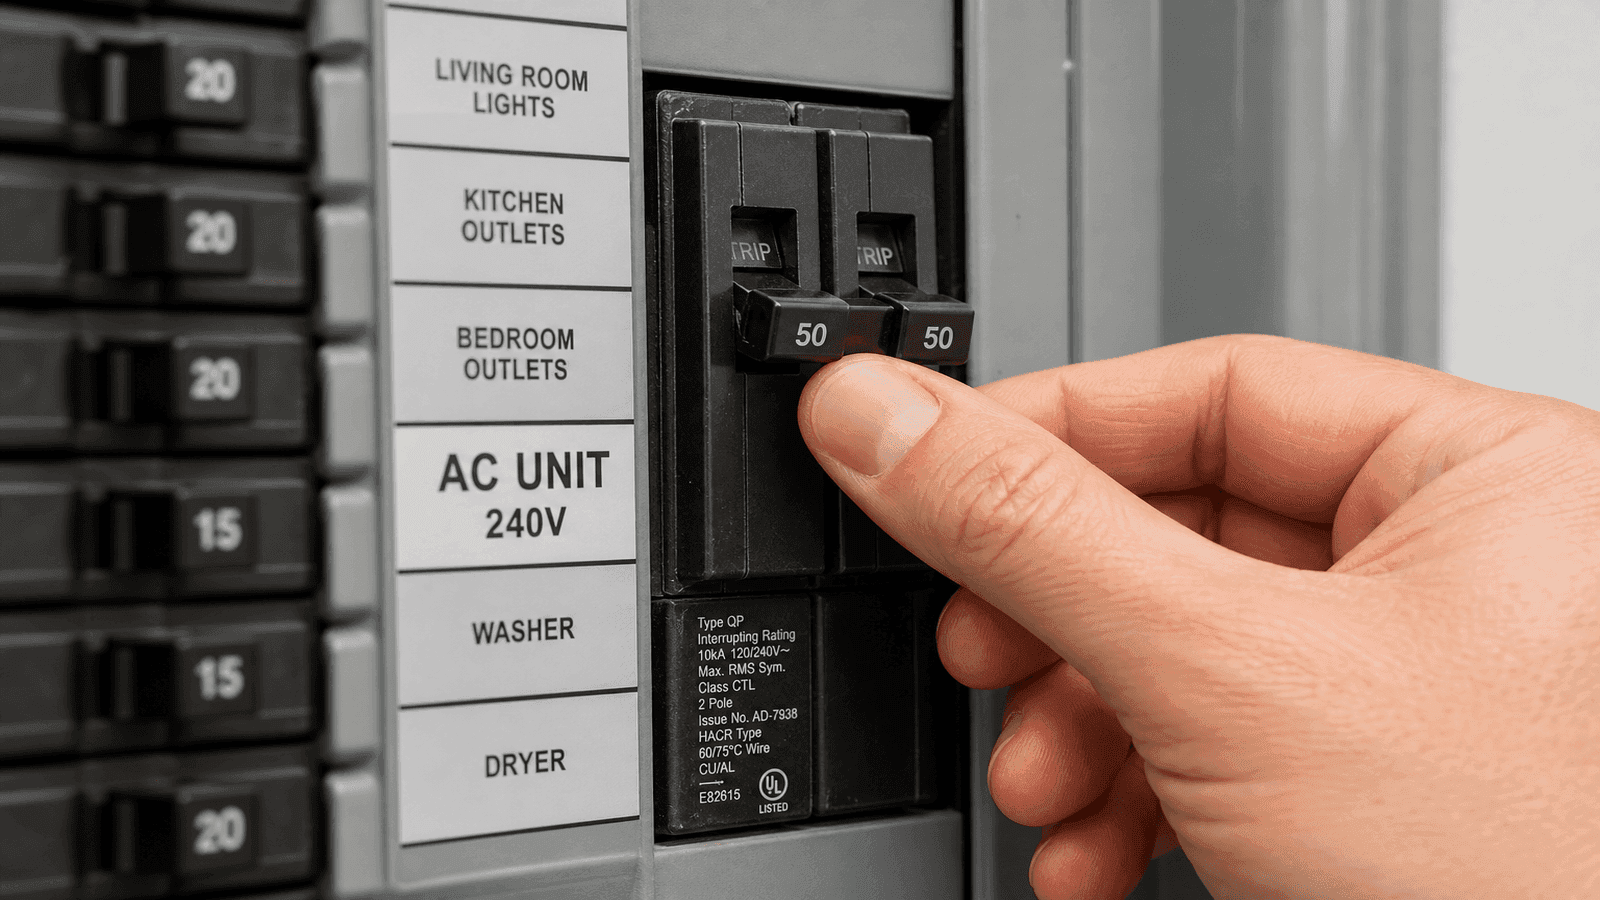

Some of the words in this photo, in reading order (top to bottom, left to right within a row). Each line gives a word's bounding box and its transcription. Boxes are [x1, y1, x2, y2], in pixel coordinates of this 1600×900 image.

[187, 59, 235, 101] 20
[437, 60, 512, 85] LIVING
[522, 66, 587, 91] ROOM
[475, 93, 554, 118] LIGHTS
[465, 190, 563, 214] KITCHEN
[188, 212, 235, 253] 20
[462, 220, 564, 245] OUTLETS
[458, 328, 573, 349] BEDROOM
[796, 323, 827, 346] 50
[924, 327, 953, 349] 50
[191, 358, 240, 399] 20
[465, 359, 567, 380] OUTLETS
[439, 453, 498, 491] AC
[517, 451, 609, 490] UNIT
[196, 508, 241, 550] 15
[487, 507, 566, 538] 240V
[473, 617, 574, 644] WASHER
[698, 617, 723, 631] Type
[727, 615, 744, 627] QP
[698, 630, 758, 645] Interrupting
[763, 629, 795, 642] Rating
[699, 648, 725, 661] 10kA
[198, 656, 242, 697] 15
[699, 665, 724, 677] Max.
[729, 662, 755, 675] RMS
[759, 662, 785, 675] Sym.
[699, 682, 728, 693] Class
[733, 679, 755, 691] CTL
[699, 699, 705, 710] 2
[709, 697, 732, 709] Pole
[699, 715, 727, 726] Issue
[732, 712, 749, 723] No.
[752, 708, 797, 722] AD-7938
[699, 729, 732, 742] HACR
[736, 728, 761, 741] Type
[746, 743, 770, 754] Wire
[486, 749, 565, 777] DRYER
[699, 764, 735, 775] CU/AL
[700, 789, 740, 803] E82615
[759, 802, 788, 813] LISTED
[196, 807, 245, 853] 20
